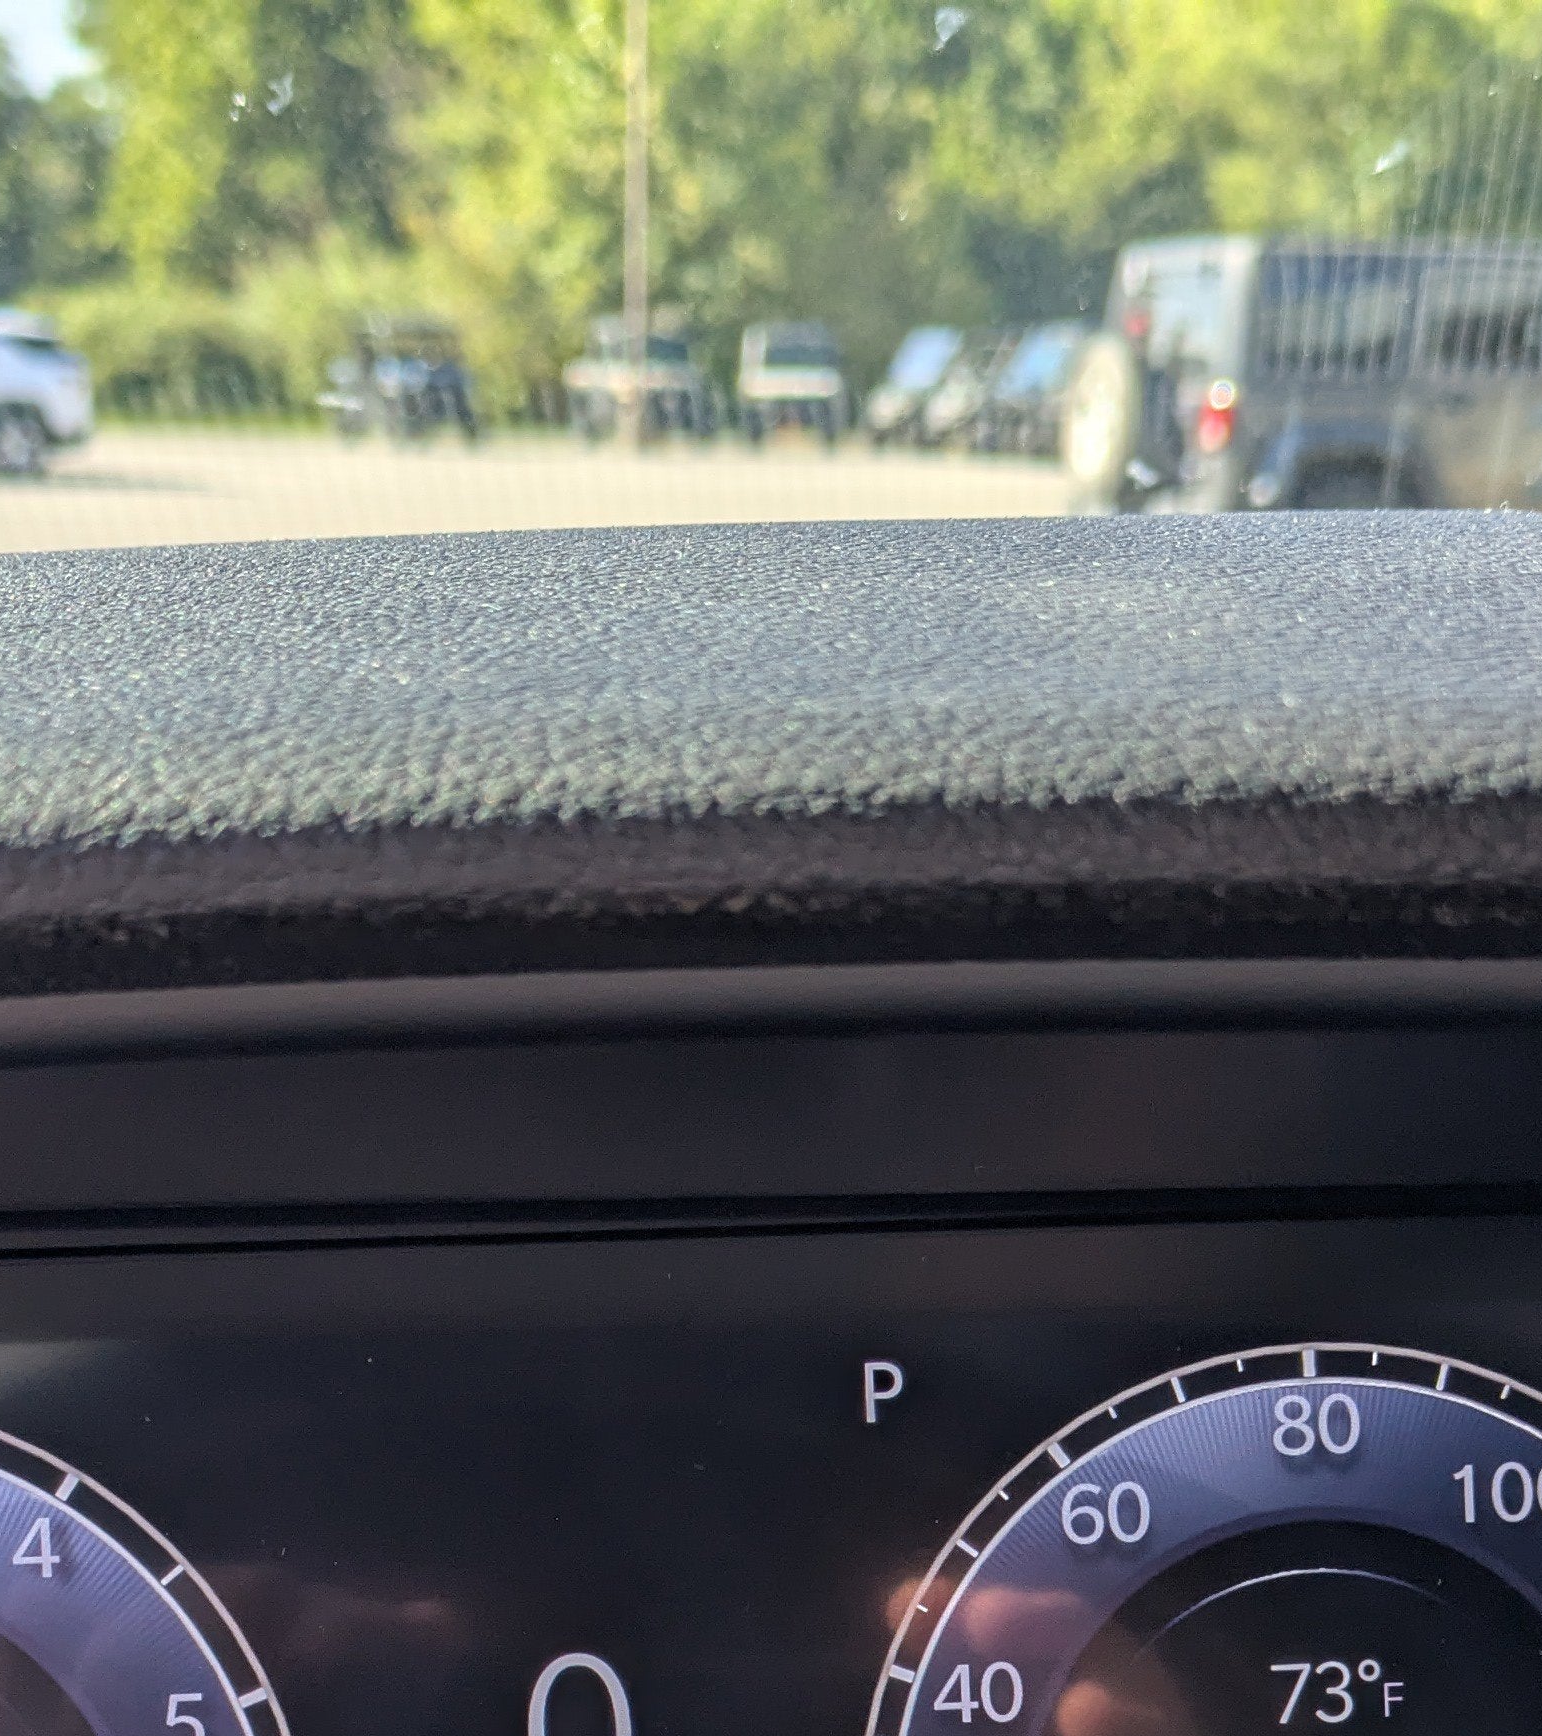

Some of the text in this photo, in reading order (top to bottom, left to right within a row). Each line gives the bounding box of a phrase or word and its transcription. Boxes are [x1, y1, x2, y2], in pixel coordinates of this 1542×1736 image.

[862, 1361, 904, 1423] P
[1271, 1393, 1362, 1456] 80
[1060, 1480, 1152, 1545] 60
[11, 1517, 62, 1579] 4
[932, 1659, 1025, 1724] 40
